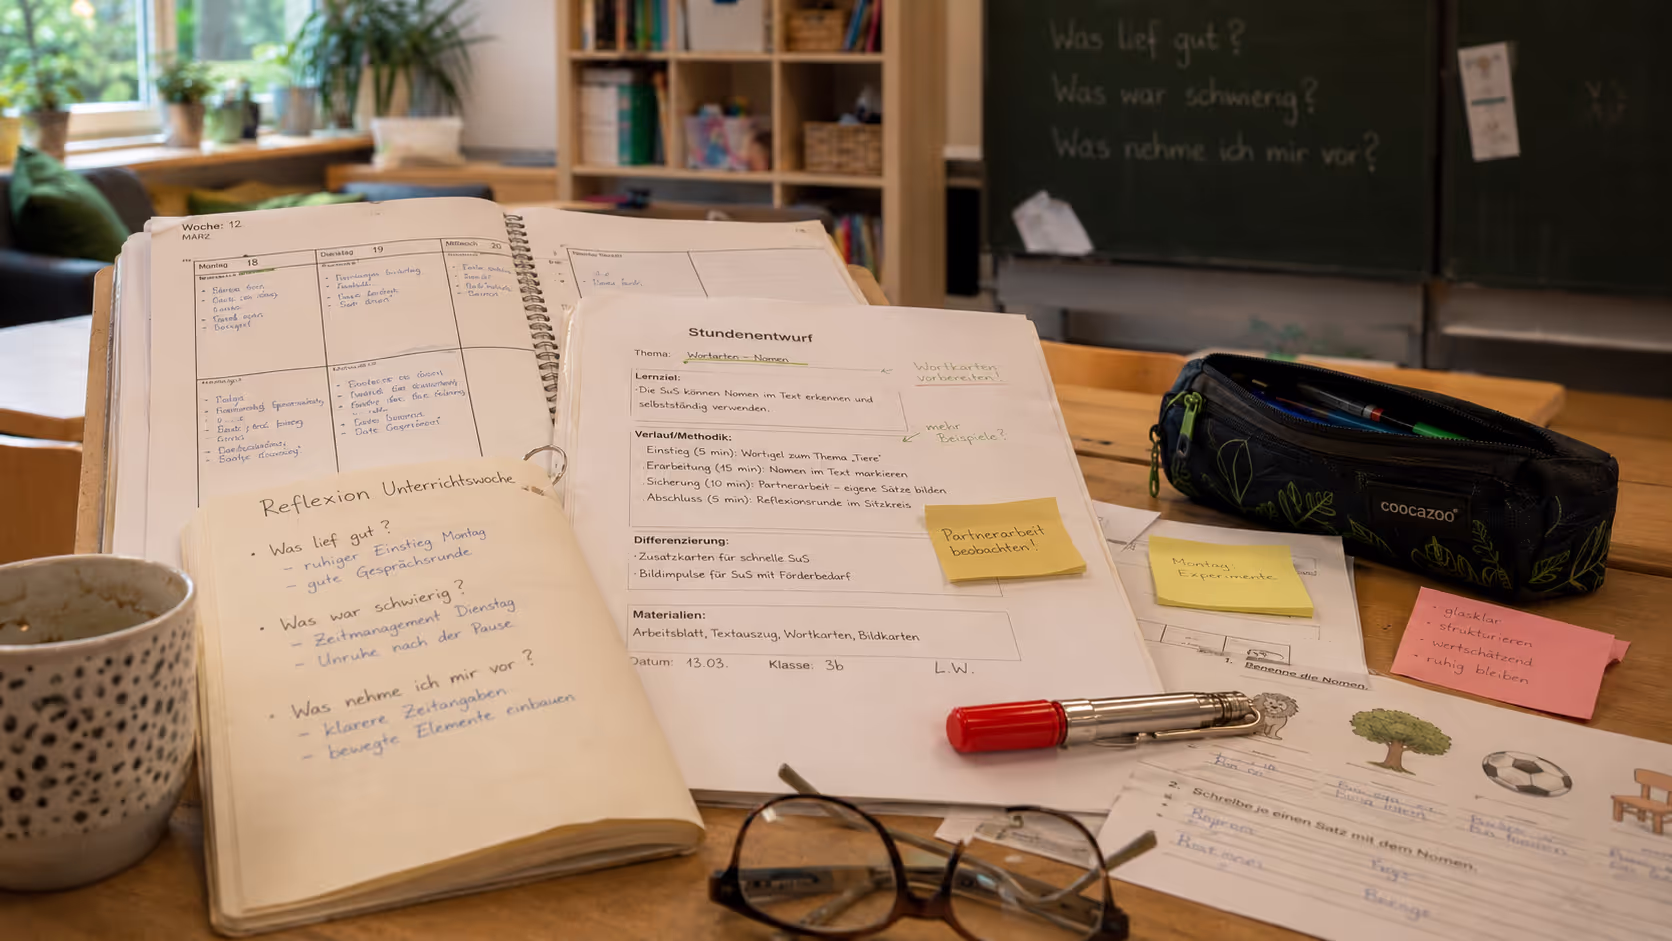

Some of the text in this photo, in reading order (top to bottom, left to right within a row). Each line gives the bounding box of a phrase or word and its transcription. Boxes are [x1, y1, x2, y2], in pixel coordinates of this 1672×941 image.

[1051, 18, 1103, 50] Was
[1118, 18, 1161, 60] lief
[1052, 72, 1106, 106] Was
[1121, 88, 1167, 106] war
[1052, 126, 1110, 160] Was
[1124, 129, 1206, 161] nehme
[1219, 130, 1254, 161] ich
[1266, 141, 1309, 163] mir
[182, 220, 242, 232] Woche: 12
[372, 246, 384, 254] 19
[491, 242, 502, 250] 20
[247, 258, 259, 267] 18
[688, 327, 814, 343] Stundenentwurf
[754, 354, 790, 363] Nomen
[638, 386, 656, 395] Die
[660, 386, 680, 396] SuS
[684, 387, 720, 397] können
[724, 390, 759, 398] Nomen
[780, 392, 802, 400] Text
[806, 393, 851, 402] erkennen
[854, 396, 874, 404] und
[639, 400, 708, 413] selbstständig
[926, 421, 960, 431] mehr
[635, 430, 732, 442] Verlauf/Methodik:
[646, 445, 690, 458] Einstieg
[813, 452, 848, 462] Thema
[646, 461, 711, 474] Erarbeitung
[714, 463, 732, 474] (15
[769, 466, 806, 475] Nomen
[811, 468, 824, 476] im
[827, 468, 850, 477] Text
[855, 470, 908, 478] markieren
[260, 471, 516, 518] Reflexion Unterrichtswoche
[646, 477, 700, 490] Sicherung
[704, 478, 722, 488] (10
[758, 480, 830, 491] Partnerarbeit
[844, 485, 877, 495] eigene
[914, 485, 948, 494] bilden
[646, 492, 702, 503] Abschluss
[756, 495, 842, 507] Reflexionsrunde
[848, 500, 861, 508] im
[864, 500, 912, 509] Sitzkreis
[634, 535, 729, 548] Differenzierung:
[941, 524, 1045, 542] Partnerarbeit
[269, 541, 302, 557] Was
[313, 533, 338, 549] lief
[303, 527, 487, 572] ruhiger Einstieg Montag
[950, 538, 1039, 557] beobachten!
[638, 552, 810, 564] Zusatzkarten für schnelle SuS
[307, 547, 473, 594] gute Gesprächsrunde
[639, 568, 705, 582] Bildimpulse
[709, 570, 727, 580] für
[731, 570, 754, 580] SuS
[756, 571, 775, 580] mit
[280, 614, 317, 632] Was
[330, 608, 361, 622] war
[314, 598, 516, 648] Zeitmanagement Dienstag
[632, 610, 706, 620] Materialien:
[1444, 607, 1502, 624] glasklar
[318, 618, 514, 668] Unruhe nach der Pause
[632, 627, 920, 642] Arbeitsblatt, Textauszug, Wortkarten, Bildkarten
[1440, 623, 1533, 648] strukturieren
[1432, 640, 1533, 667] wertschätzend
[686, 657, 729, 669] 13.03.
[768, 659, 814, 670] Klasse:
[824, 658, 844, 672] 3b
[934, 660, 975, 675] L.W.
[1426, 656, 1529, 684] ruhig bleiben
[291, 700, 332, 720] Was
[345, 687, 402, 709] nehme
[414, 675, 440, 692] ich
[450, 668, 478, 685] mir
[324, 686, 508, 738] klarere Zeitangaben
[329, 693, 576, 760] bewegte Elemente einbauen
[1272, 810, 1312, 827] einen
[1315, 820, 1348, 837] Satz
[1351, 831, 1374, 844] mit
